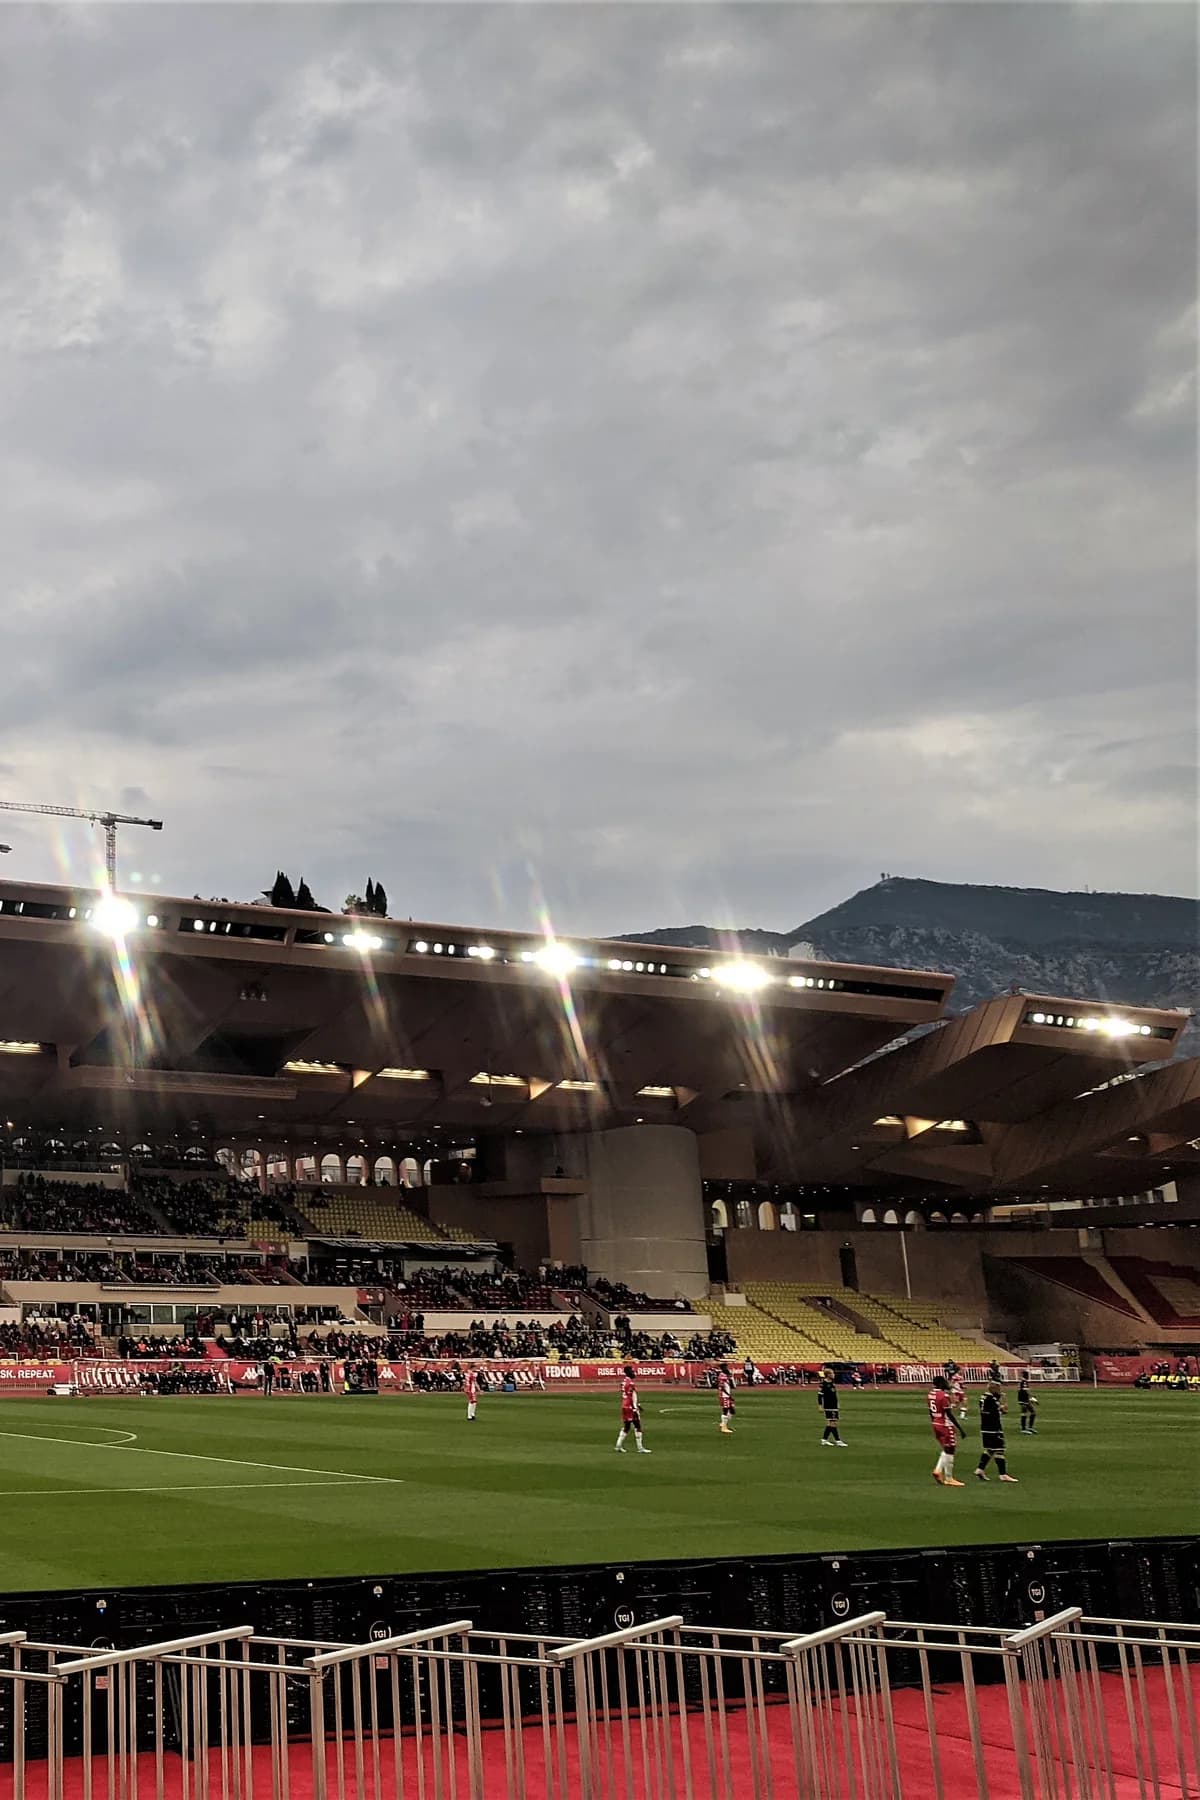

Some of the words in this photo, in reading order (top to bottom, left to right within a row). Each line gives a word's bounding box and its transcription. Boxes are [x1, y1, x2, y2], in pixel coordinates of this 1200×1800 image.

[18, 1369, 55, 1379] REPEAT.
[545, 1365, 581, 1378] FEDCOM
[637, 1367, 666, 1376] REPEAT.
[617, 1614, 630, 1623] TGI
[373, 1630, 387, 1639] TGI
